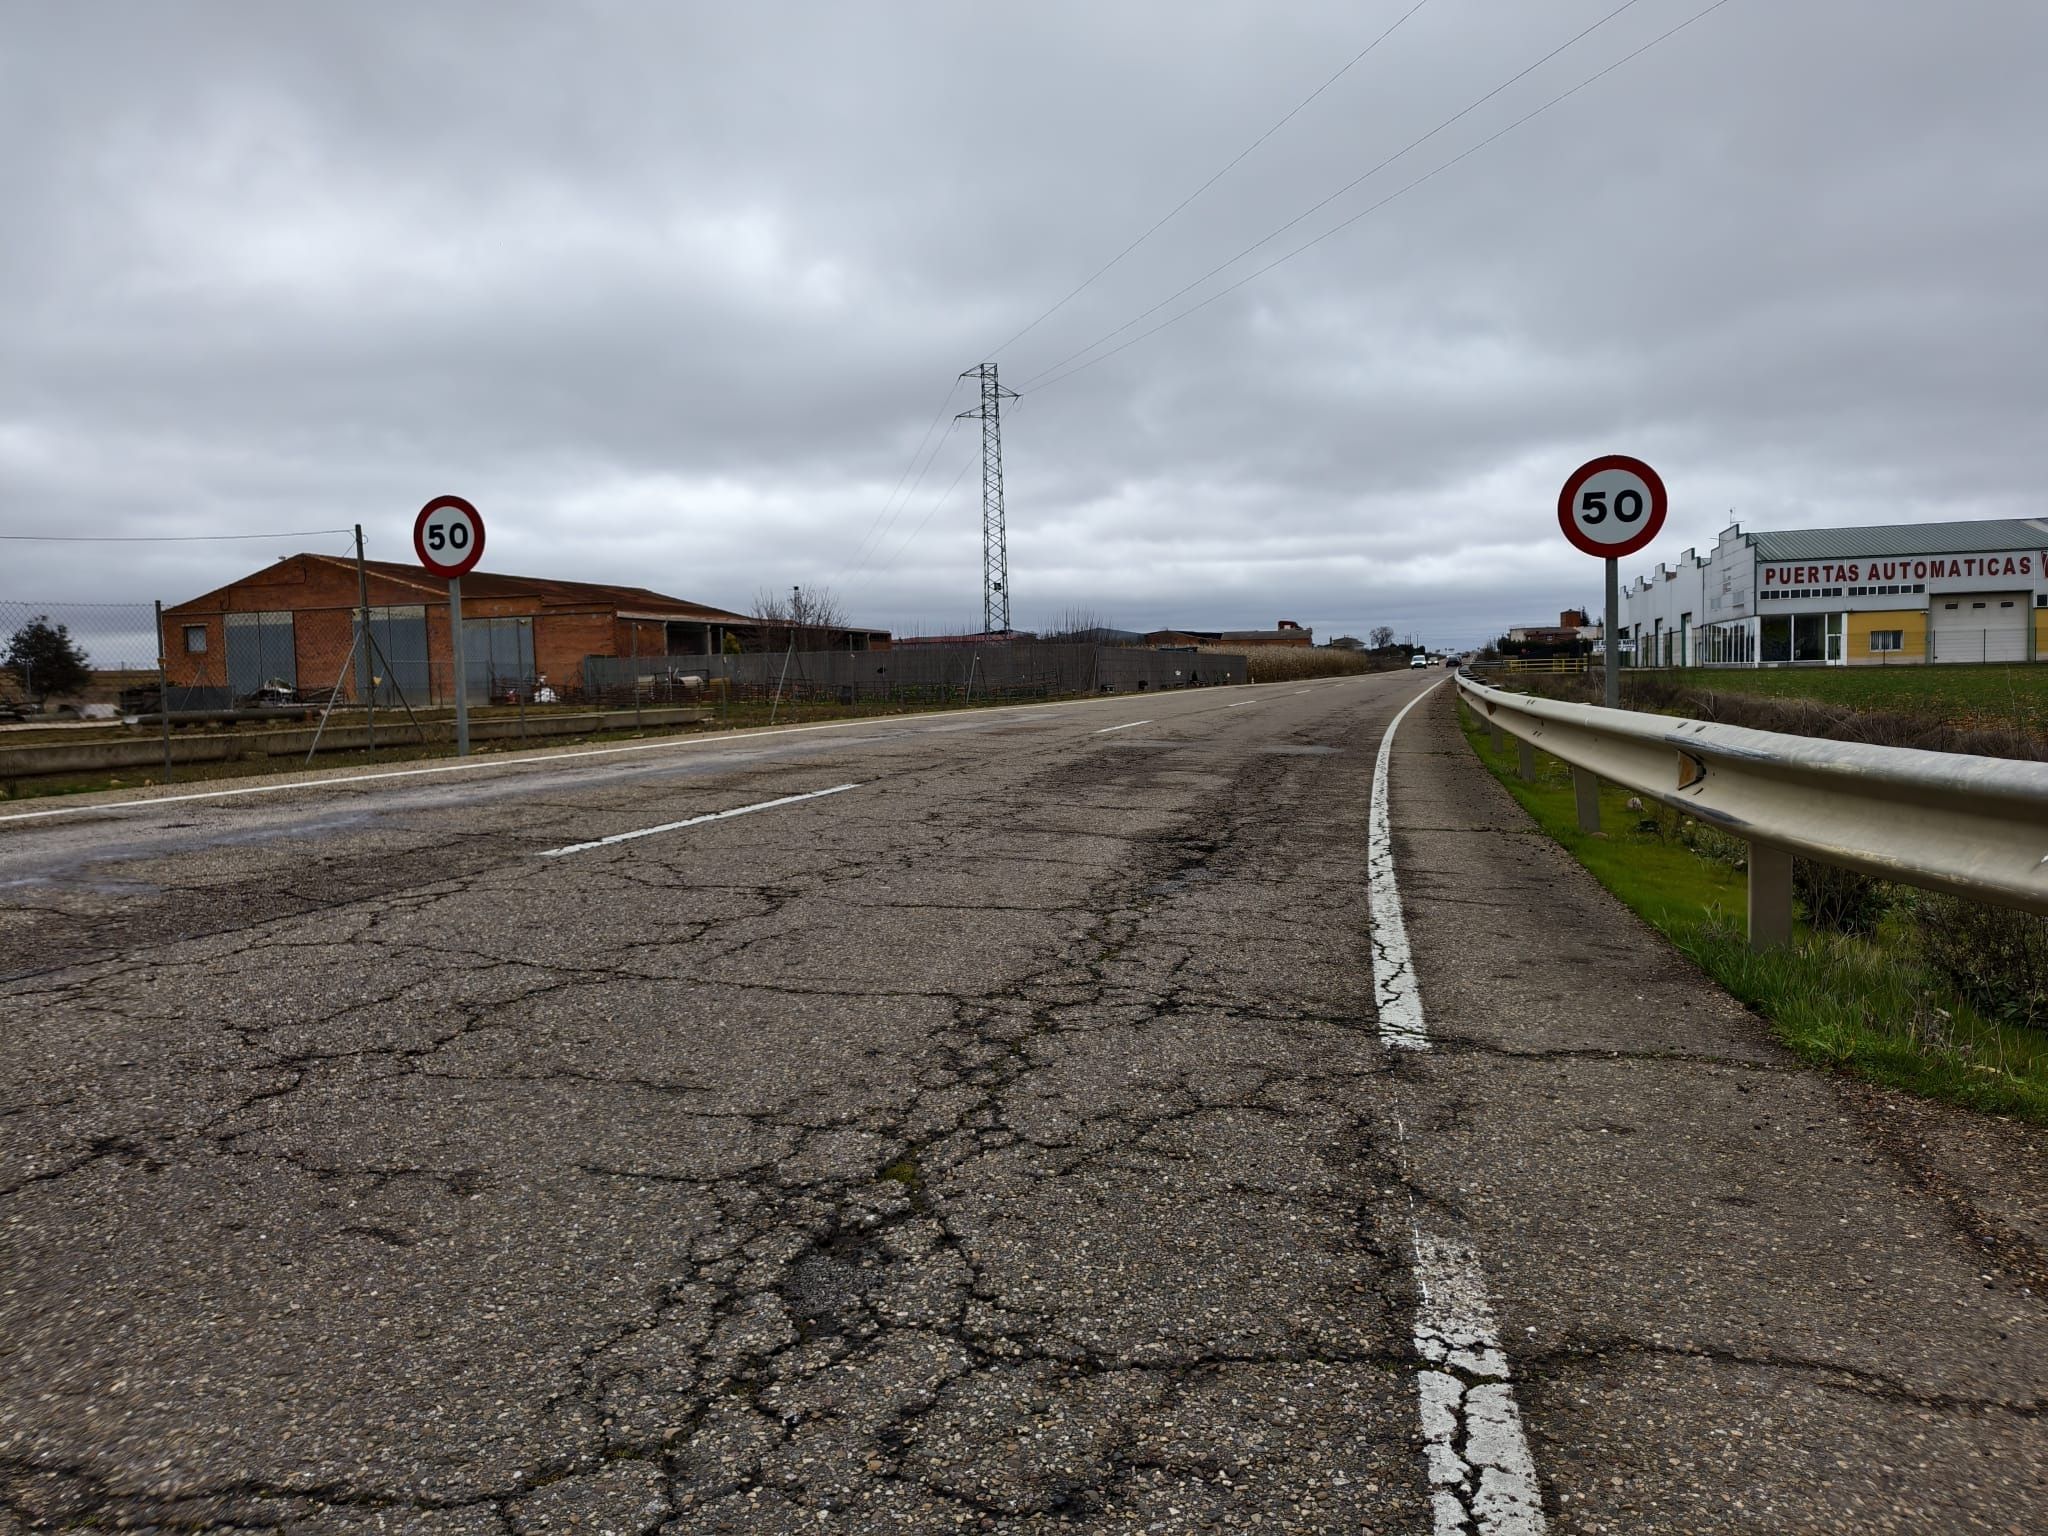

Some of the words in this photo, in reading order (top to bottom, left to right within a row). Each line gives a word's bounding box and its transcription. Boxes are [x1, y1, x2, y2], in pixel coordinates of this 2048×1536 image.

[1582, 489, 1643, 524] 50
[429, 522, 468, 551] 50
[1765, 564, 1859, 585] PUERTAS
[1868, 556, 2031, 580] AUTOMATICAS
